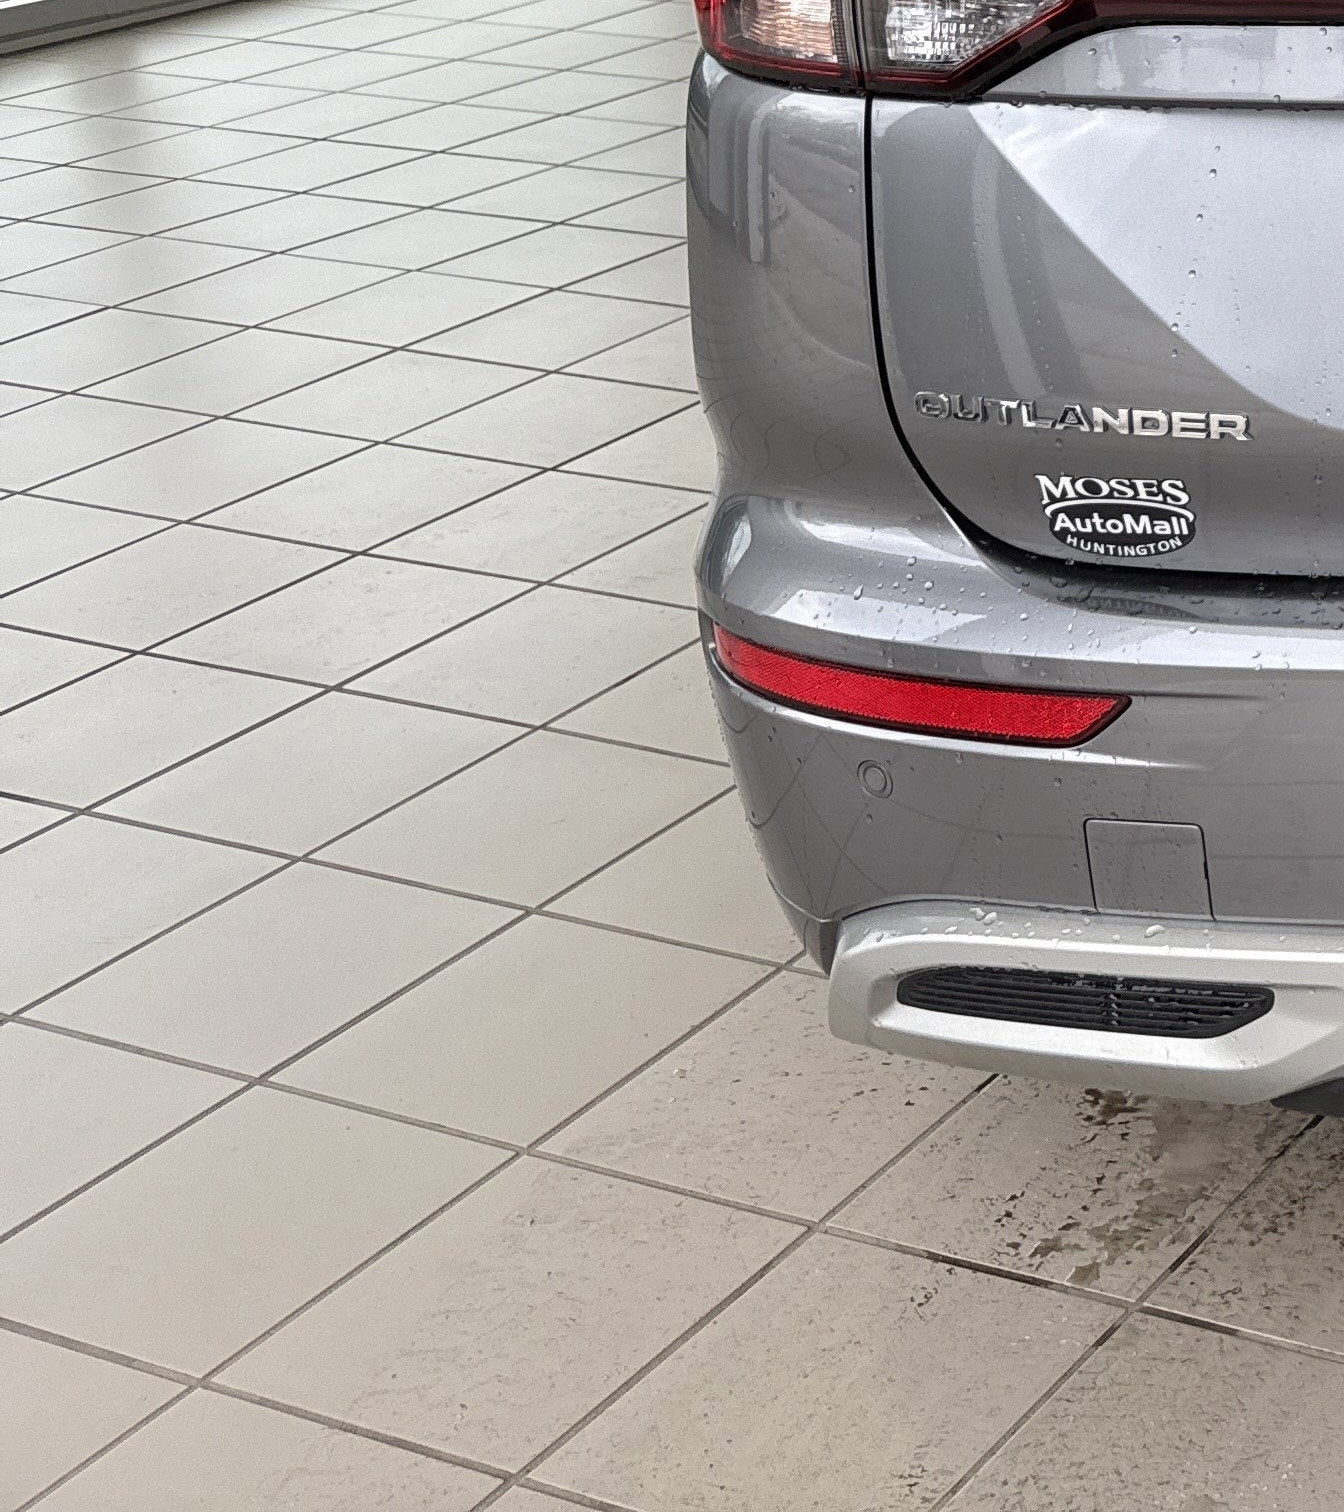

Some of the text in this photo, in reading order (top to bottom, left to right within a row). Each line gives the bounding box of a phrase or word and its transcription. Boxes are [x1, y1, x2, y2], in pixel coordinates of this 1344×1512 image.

[914, 390, 1254, 442] OUTLANDER
[1034, 474, 1190, 506] MOSES
[1053, 512, 1189, 535] AutoMall
[1066, 534, 1183, 557] HUNTINGTON
